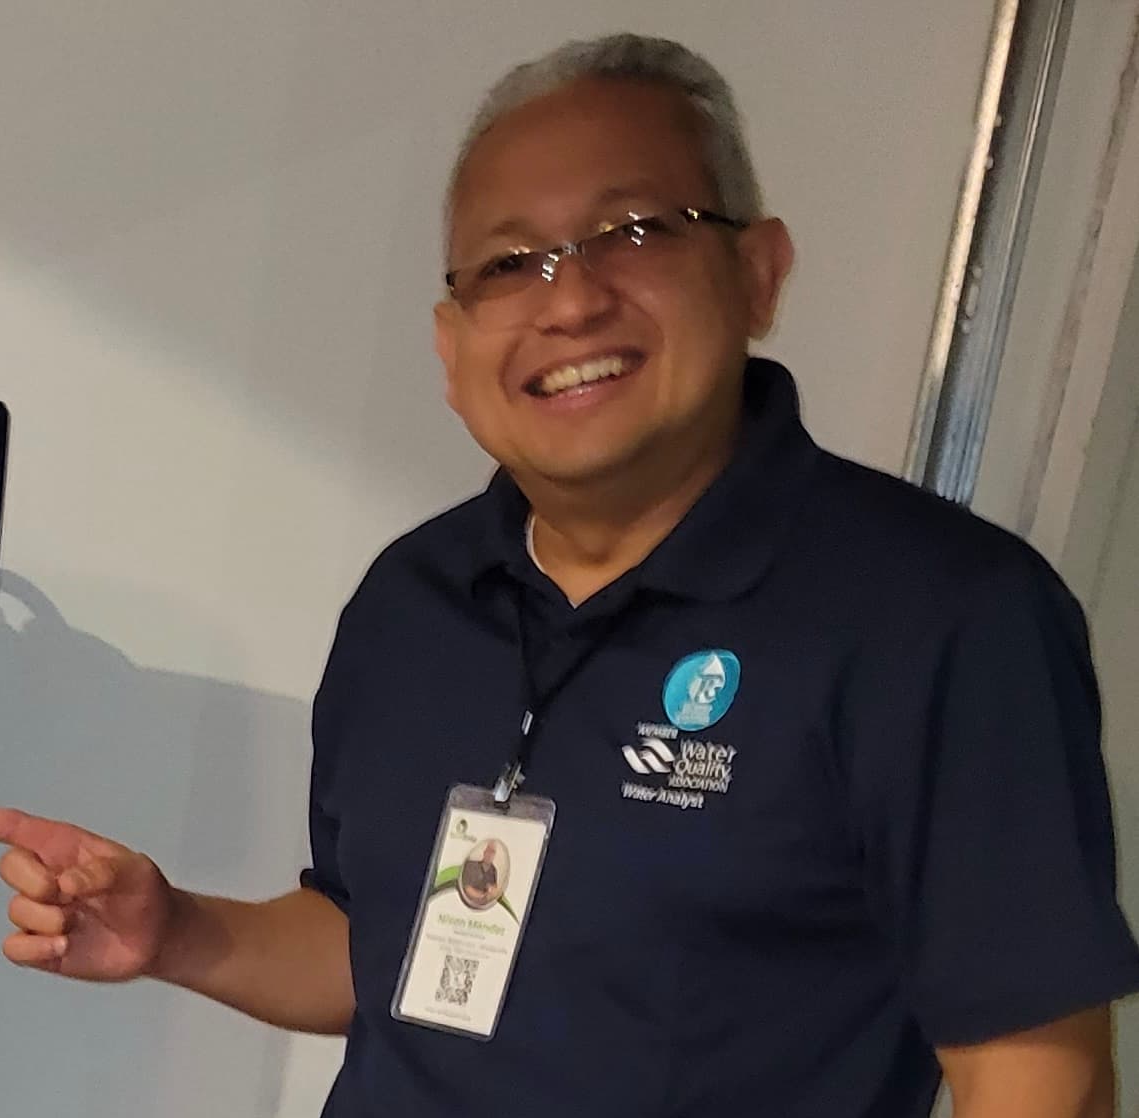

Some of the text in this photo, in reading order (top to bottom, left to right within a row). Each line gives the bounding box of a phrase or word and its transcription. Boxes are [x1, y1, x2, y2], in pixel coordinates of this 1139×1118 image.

[680, 738, 737, 763] Water
[673, 756, 731, 778] Quality
[622, 781, 704, 809] Water Analyst
